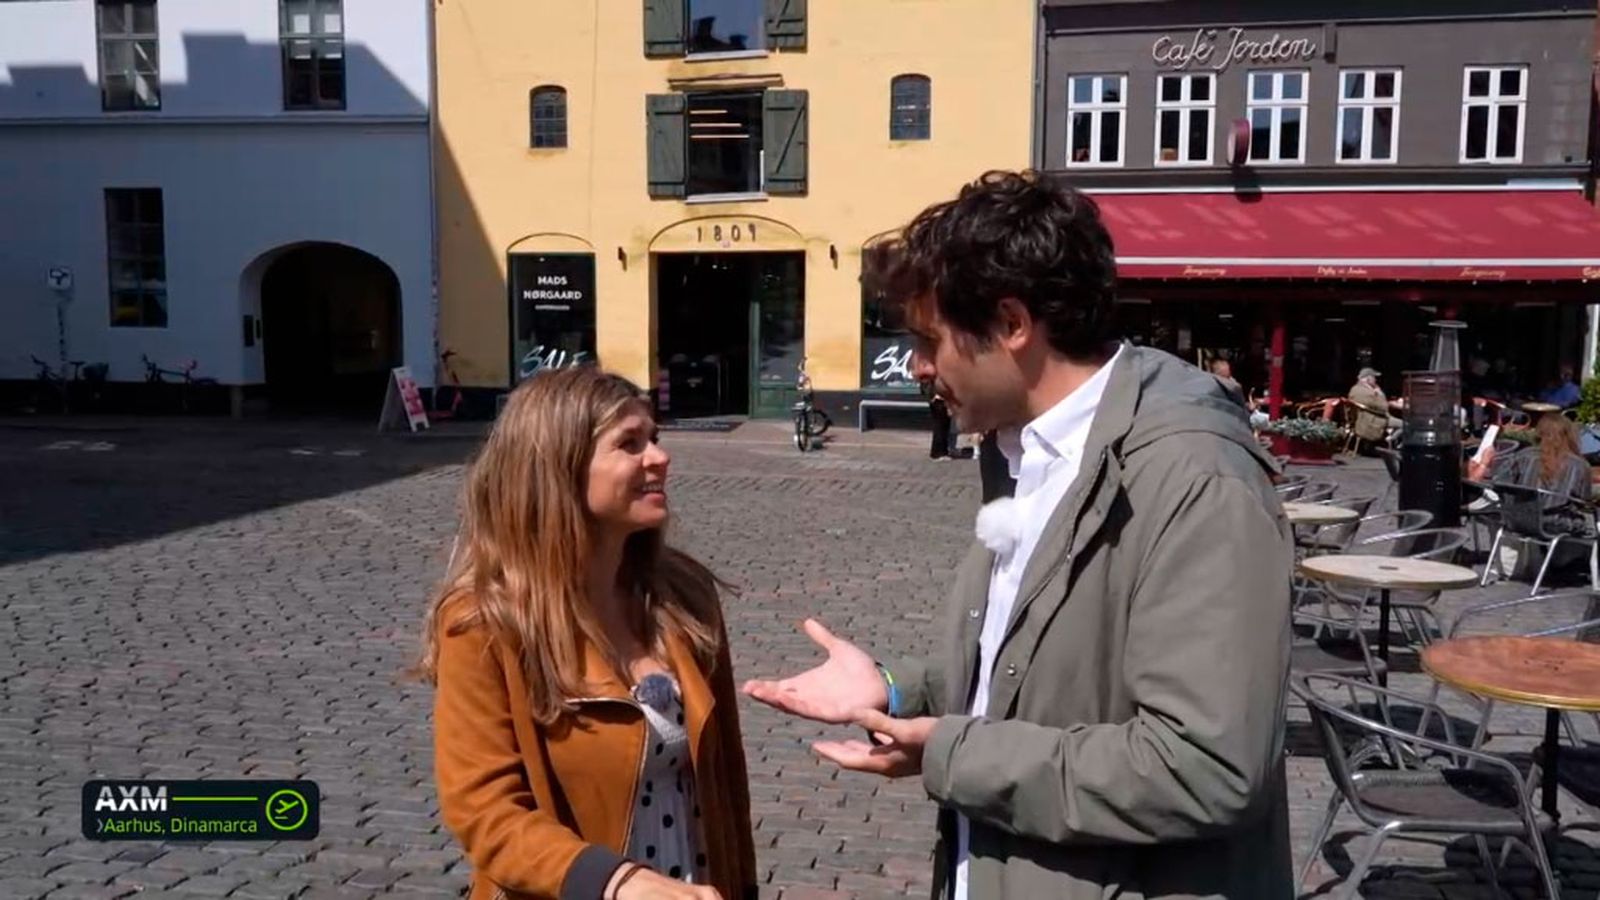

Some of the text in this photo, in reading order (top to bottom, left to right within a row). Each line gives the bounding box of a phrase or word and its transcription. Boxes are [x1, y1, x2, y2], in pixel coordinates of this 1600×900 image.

[1152, 28, 1216, 70] Café
[696, 223, 757, 243] 1809
[537, 275, 568, 286] MADS
[523, 290, 583, 300] NØRGAARD
